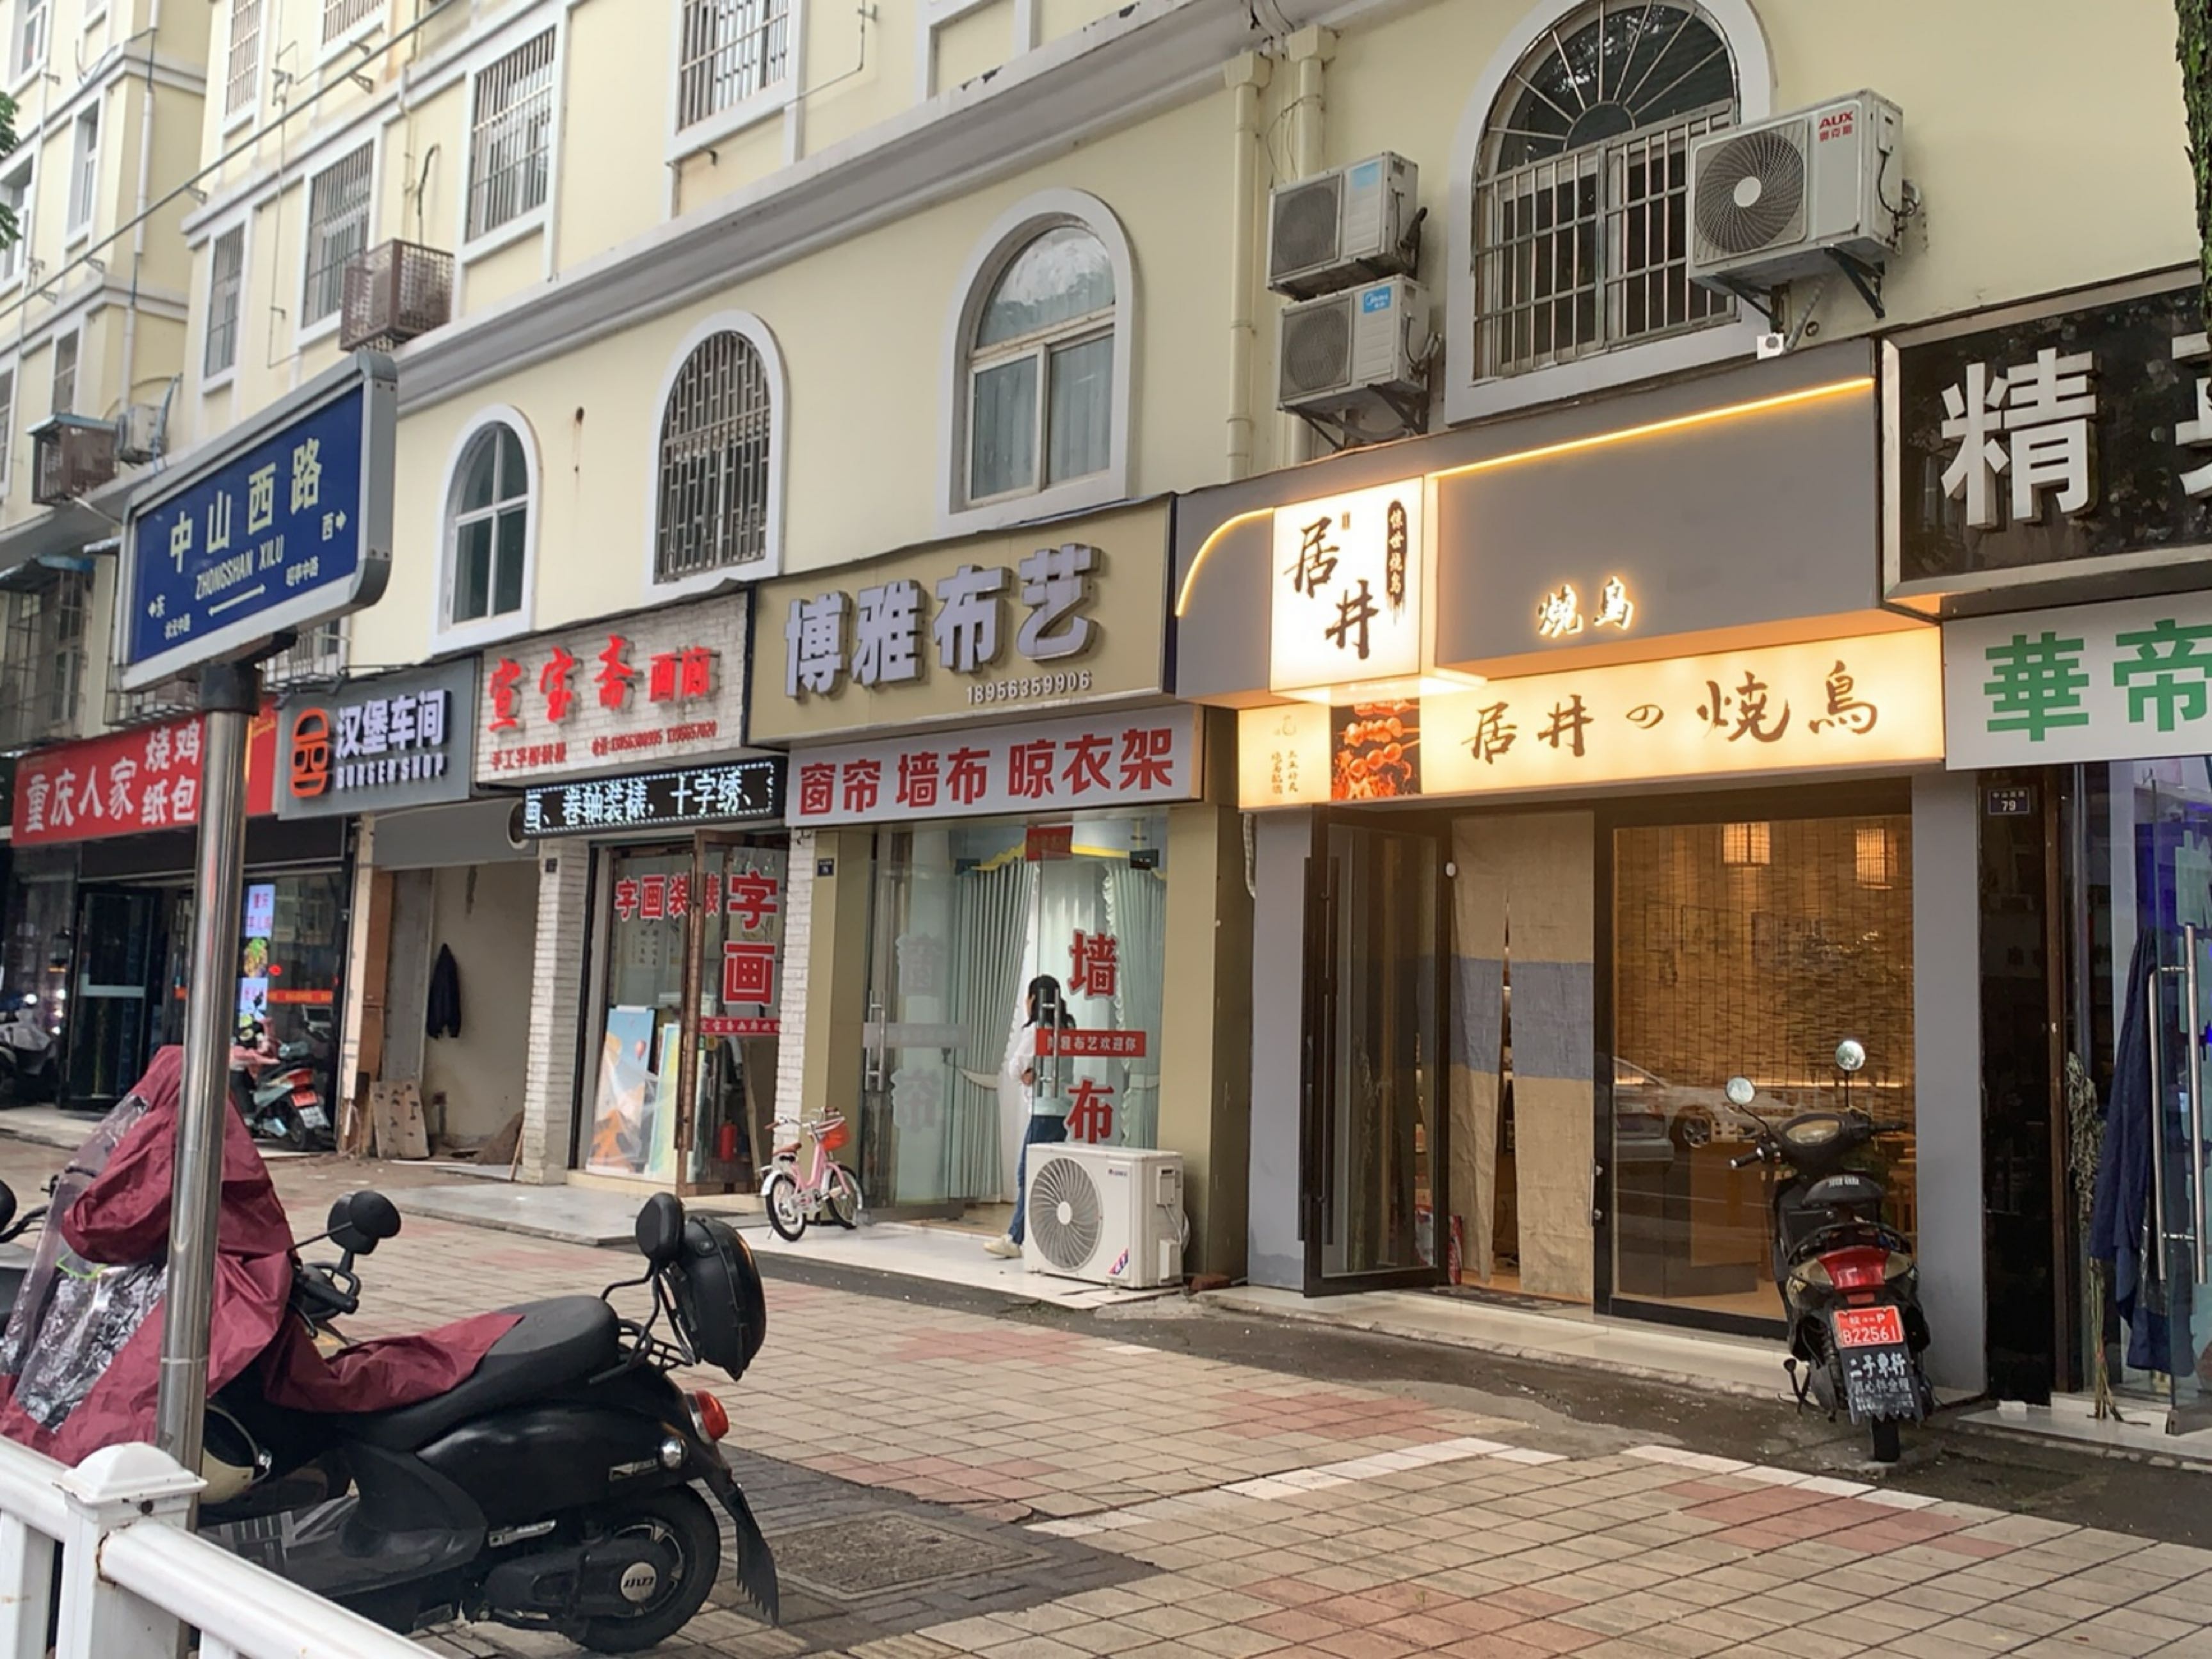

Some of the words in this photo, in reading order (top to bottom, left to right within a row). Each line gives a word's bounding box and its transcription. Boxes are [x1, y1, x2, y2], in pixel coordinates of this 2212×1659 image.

[1819, 110, 1854, 129] AUX
[170, 438, 322, 573] 中山西路
[322, 512, 333, 541] 西
[1283, 517, 1379, 660] 居井
[785, 543, 1100, 698] 博雅布艺
[966, 671, 1092, 705] 18956359906
[143, 717, 201, 773] 烧鸡
[335, 689, 451, 760] 汉堡车间
[24, 755, 138, 833] 重庆人家
[336, 758, 397, 789] BURGER
[401, 752, 444, 781] SHOP
[799, 758, 882, 817] 窗帘
[896, 746, 991, 808] 墙布
[1007, 727, 1173, 799] 晾衣架
[140, 774, 196, 826] 纸包
[2001, 799, 2016, 812] 79
[723, 870, 780, 1007] 字画
[1843, 1326, 1898, 1345] B22561
